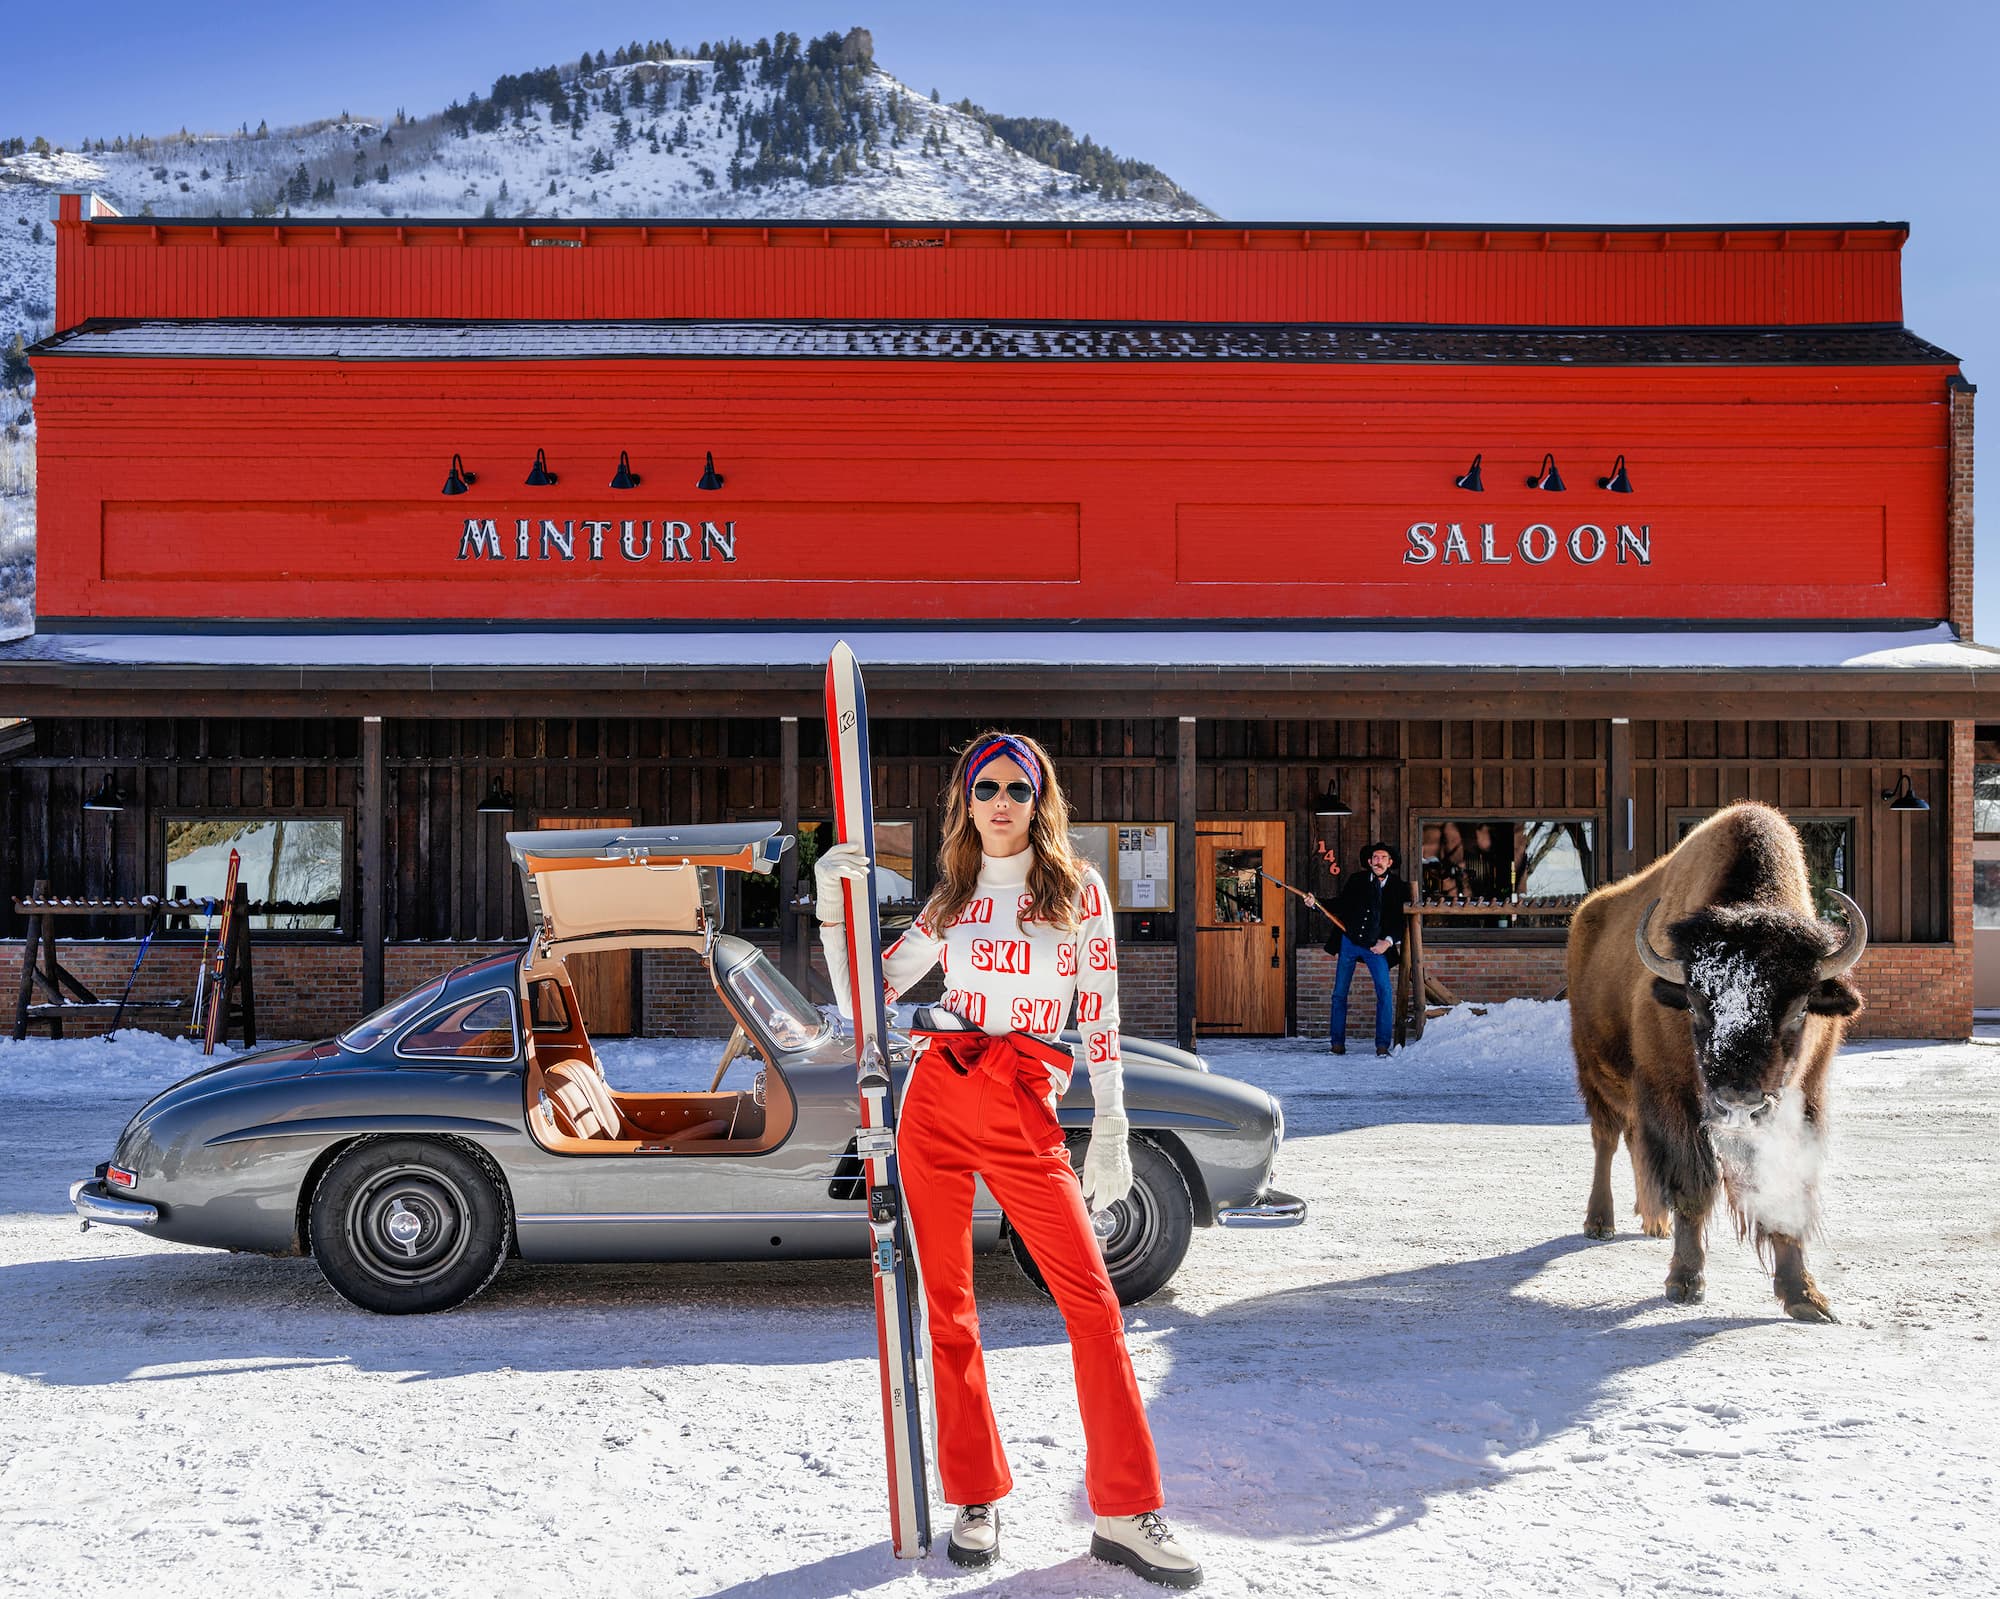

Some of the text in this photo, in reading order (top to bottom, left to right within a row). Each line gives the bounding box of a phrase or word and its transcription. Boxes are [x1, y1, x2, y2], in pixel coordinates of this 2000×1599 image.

[455, 519, 1653, 566] MINTURN SALOON
[1318, 840, 1341, 875] 146
[971, 938, 1031, 975] SKI
[1011, 997, 1061, 1034] SKI
